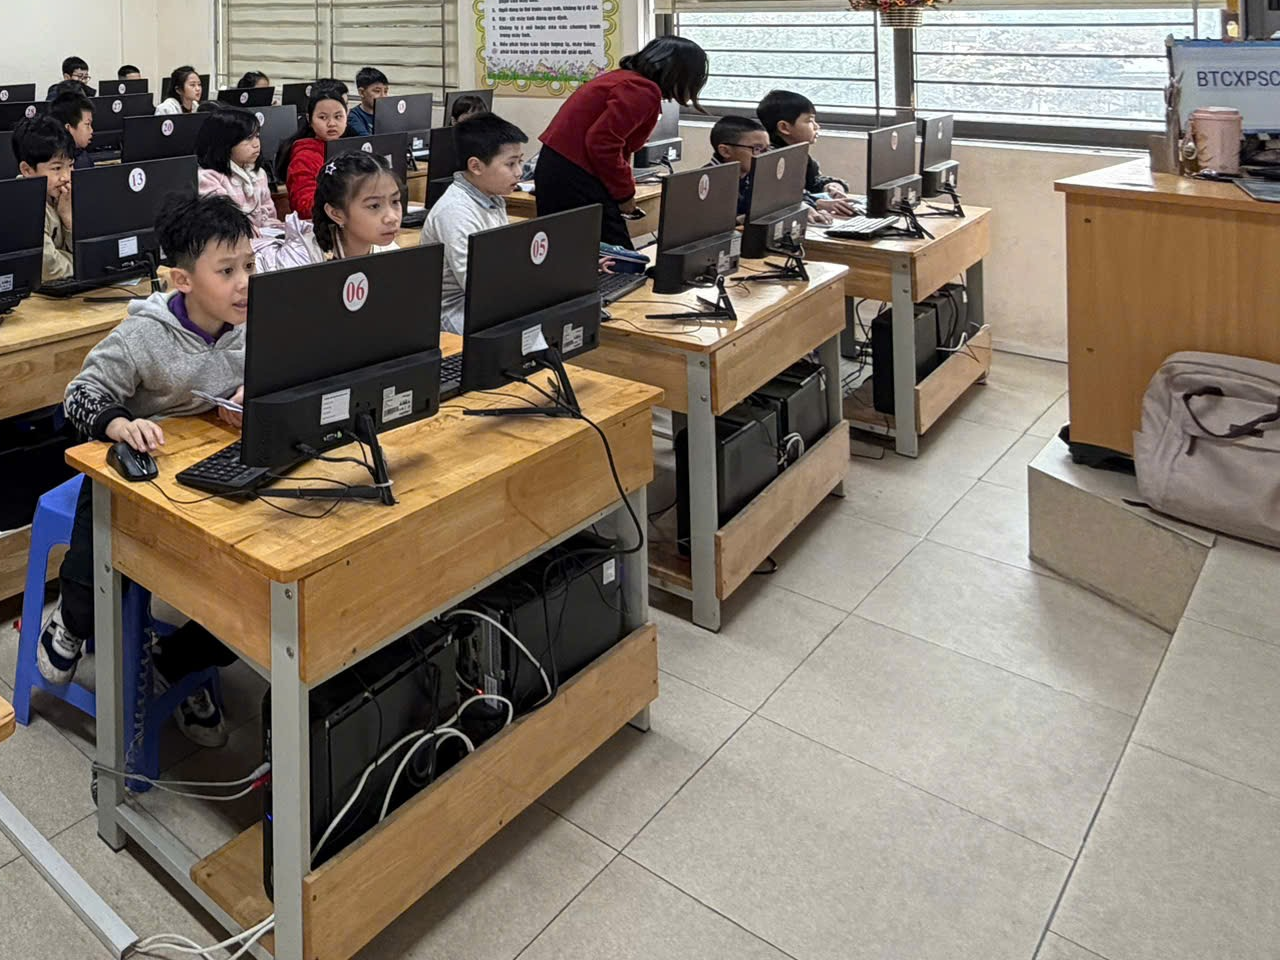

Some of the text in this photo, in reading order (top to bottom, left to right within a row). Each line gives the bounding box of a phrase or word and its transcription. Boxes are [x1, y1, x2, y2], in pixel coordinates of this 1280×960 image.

[1197, 70, 1280, 87] BTCXPSC
[163, 123, 172, 132] 20
[131, 173, 143, 186] 13
[533, 238, 545, 257] 05
[346, 279, 364, 302] 06
